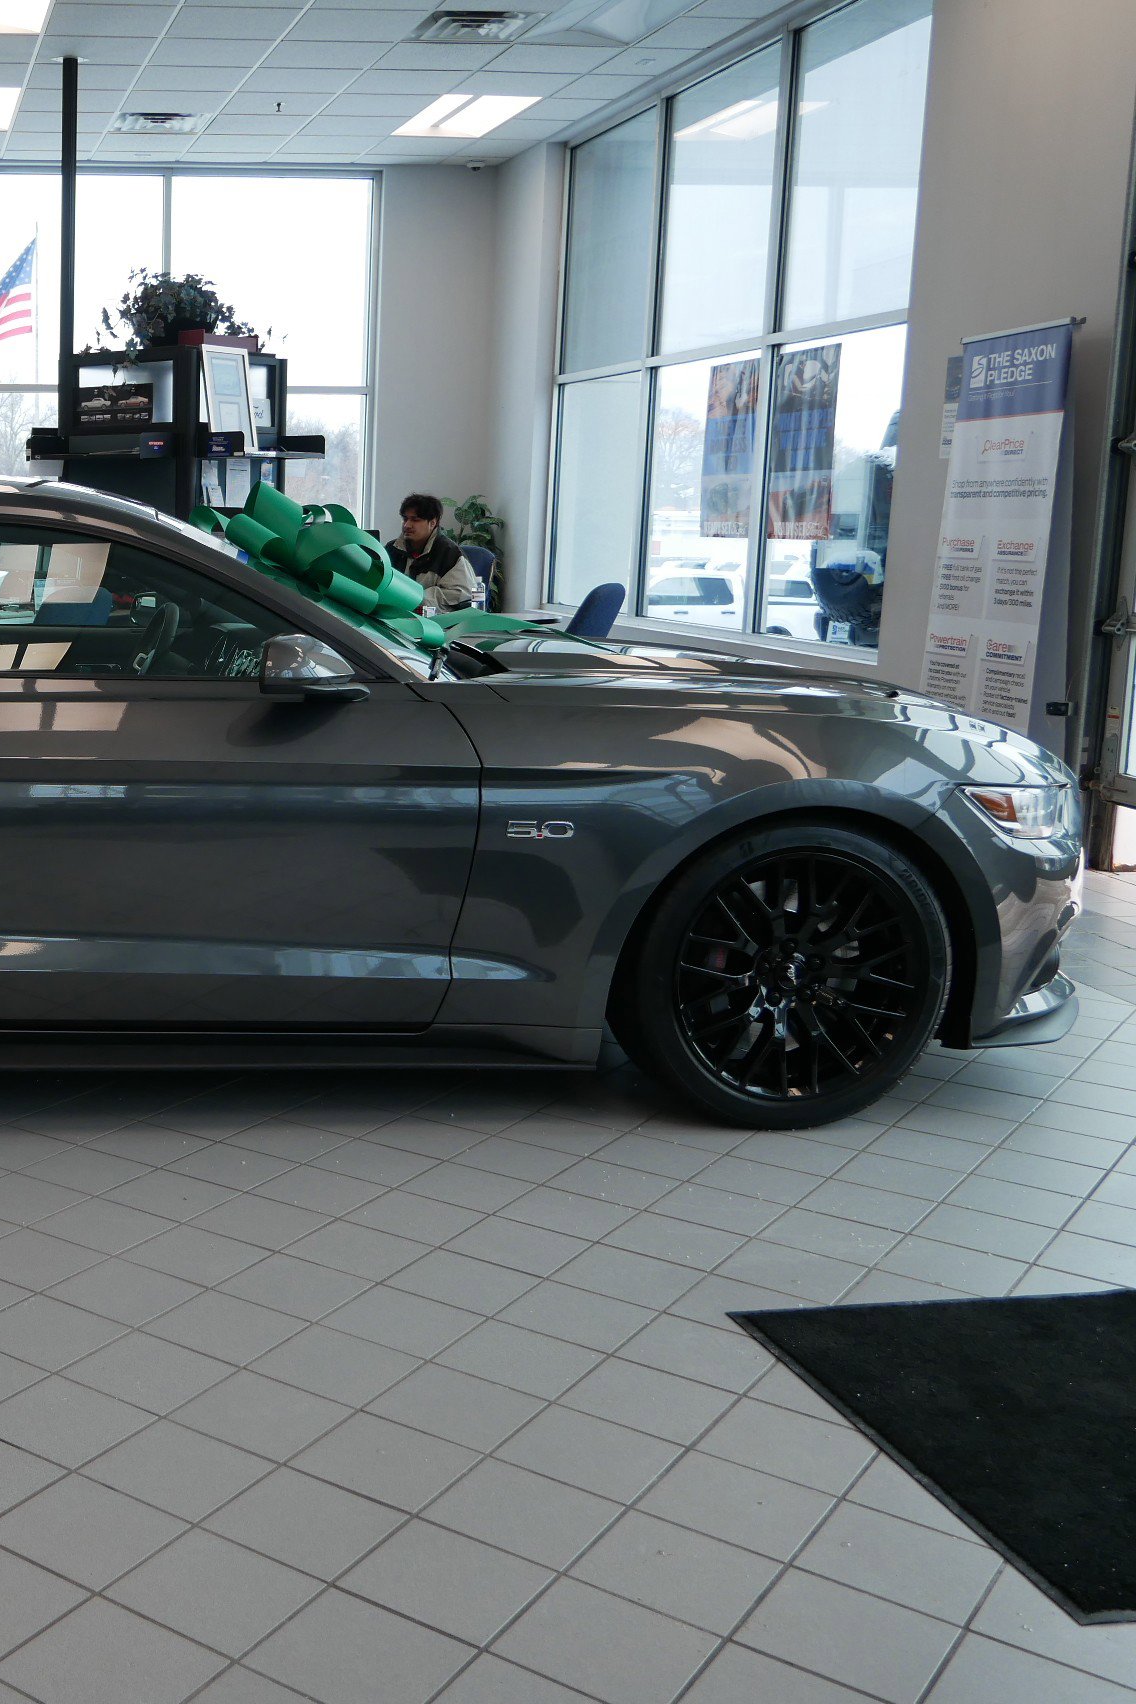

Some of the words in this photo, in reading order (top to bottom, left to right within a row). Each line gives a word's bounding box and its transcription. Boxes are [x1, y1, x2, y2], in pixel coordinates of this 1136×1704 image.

[988, 350, 1012, 369] THE
[1012, 343, 1057, 365] SAXON
[985, 364, 1034, 386] PLEDGE
[981, 438, 1024, 454] ClearPrice
[982, 489, 993, 498] and
[993, 488, 1026, 499] competitive
[942, 537, 975, 547] Purchase
[997, 540, 1034, 553] Exchange
[942, 563, 953, 571] FREE
[941, 573, 952, 581] FREE
[929, 633, 967, 647] Powertrain
[986, 639, 1008, 653] Care
[985, 651, 1023, 662] COMMITMENT
[506, 820, 575, 838] 5.0
